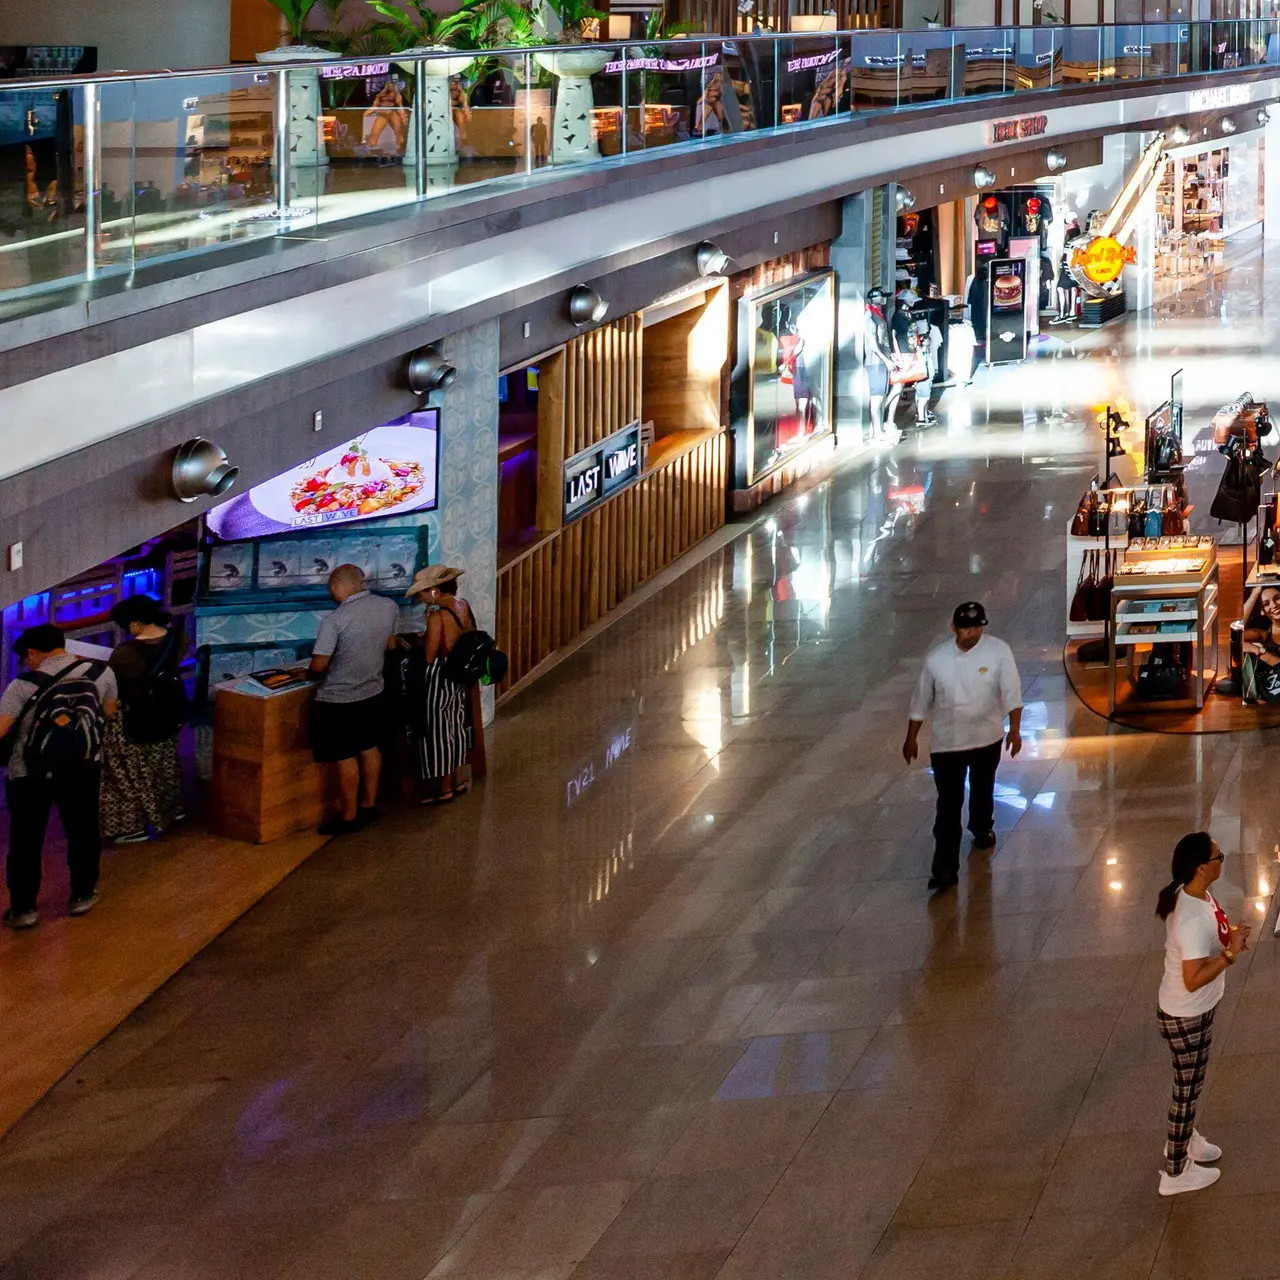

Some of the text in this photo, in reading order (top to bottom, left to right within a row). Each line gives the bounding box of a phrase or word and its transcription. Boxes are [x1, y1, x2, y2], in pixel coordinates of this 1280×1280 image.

[570, 443, 637, 503] LAST WAVE
[293, 514, 322, 526] LAST
